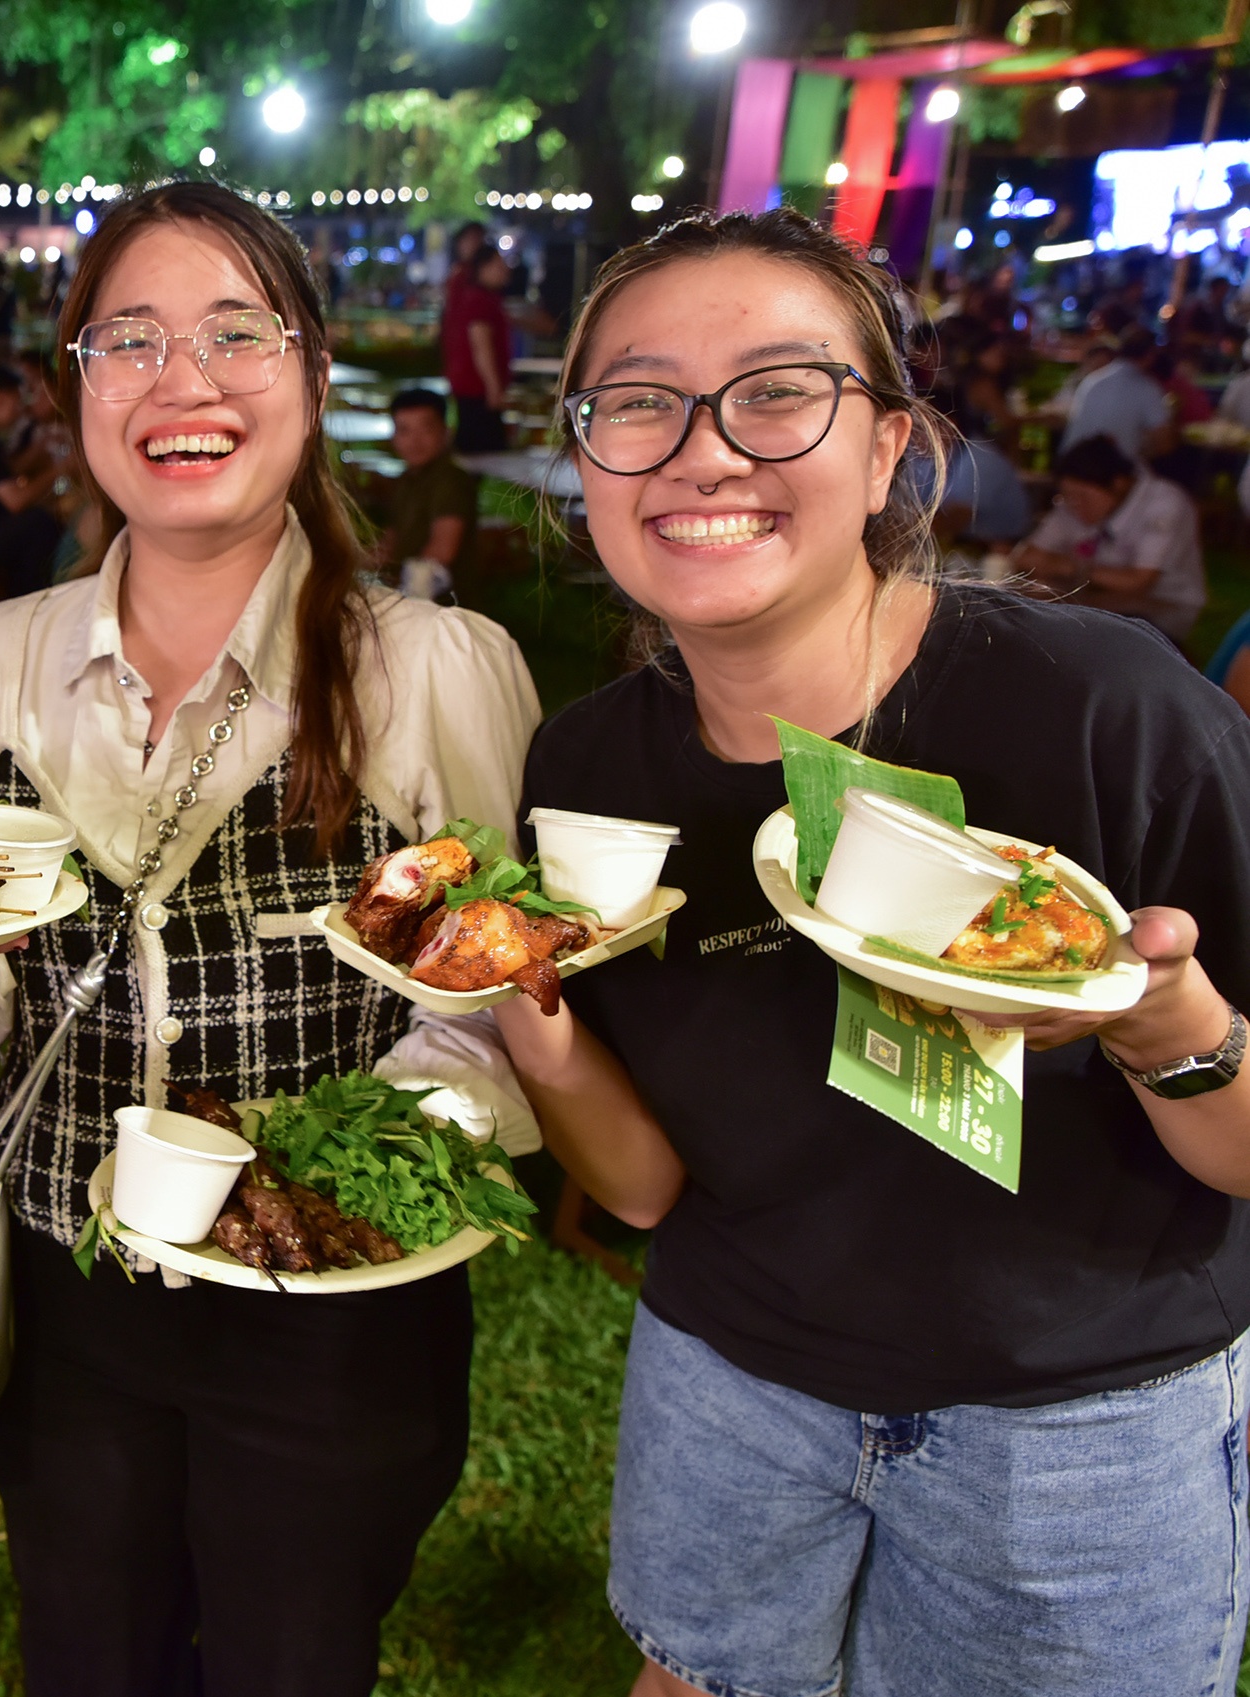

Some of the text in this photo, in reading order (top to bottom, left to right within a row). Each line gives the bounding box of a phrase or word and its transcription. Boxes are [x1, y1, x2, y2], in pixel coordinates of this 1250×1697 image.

[698, 925, 762, 955] RESPECT
[941, 1052, 953, 1086] 15:00
[974, 1069, 994, 1105] 27
[938, 1093, 952, 1132] 22:00
[971, 1118, 992, 1155] 30
